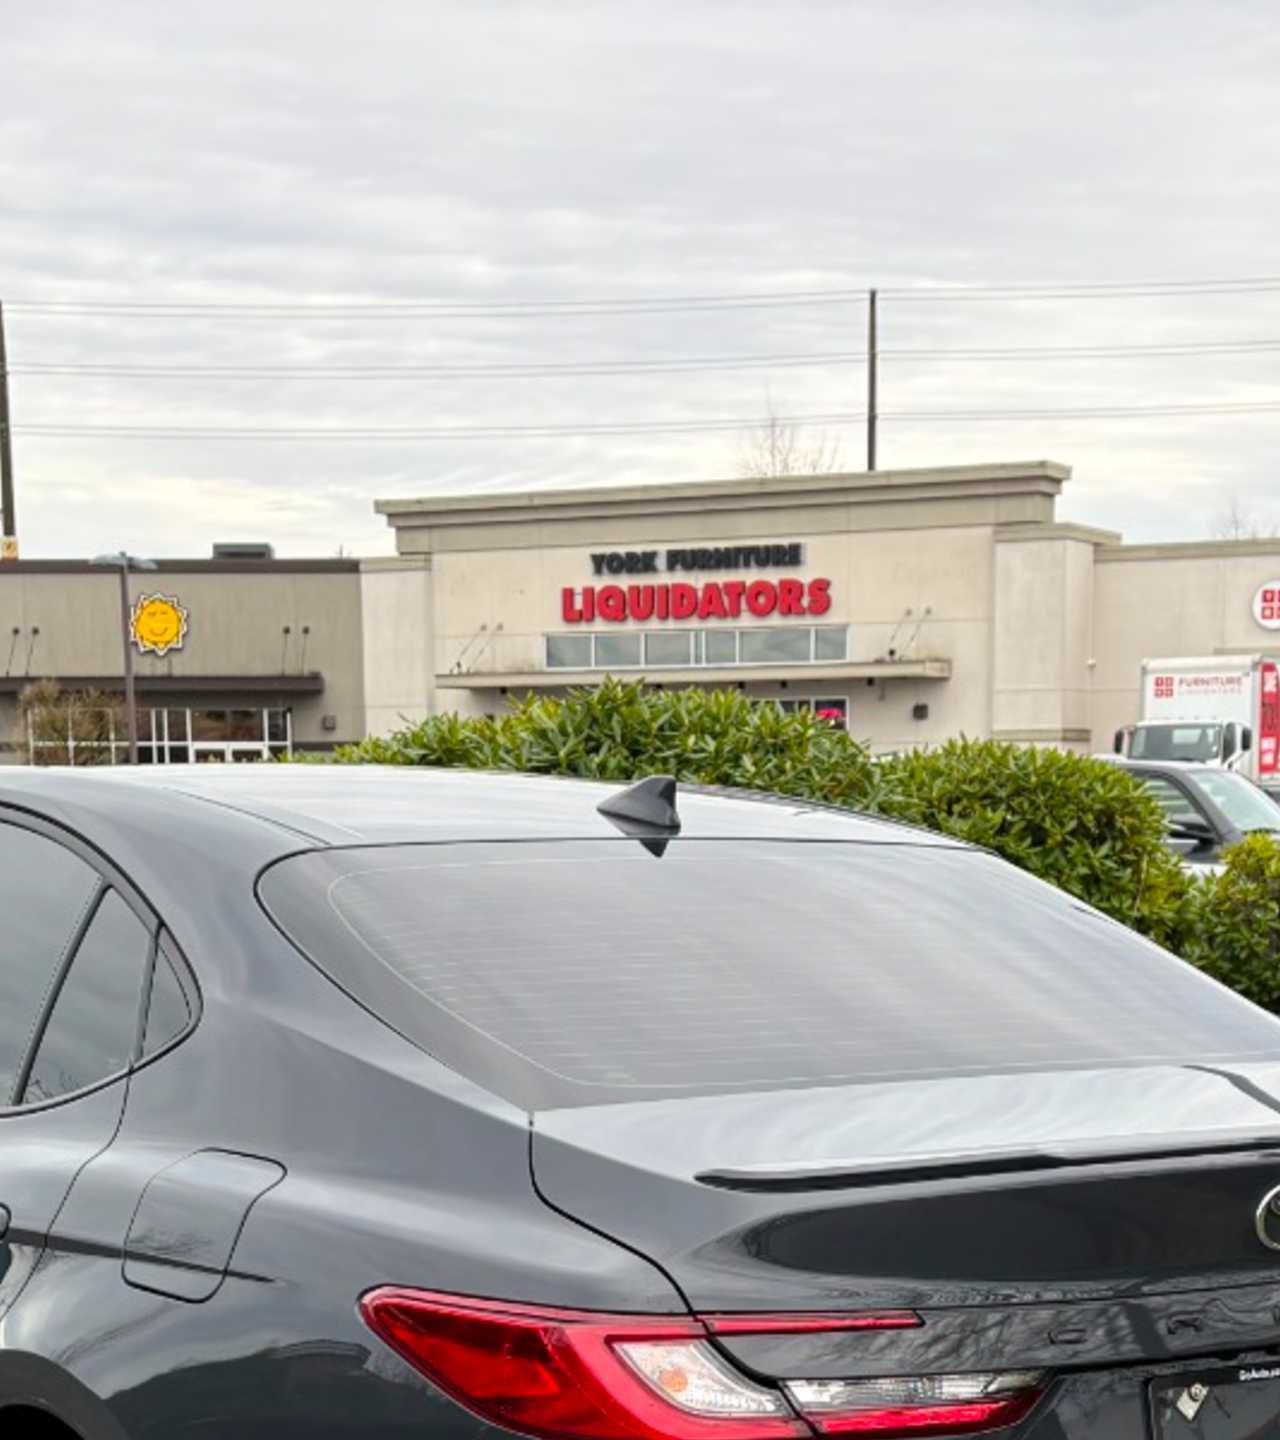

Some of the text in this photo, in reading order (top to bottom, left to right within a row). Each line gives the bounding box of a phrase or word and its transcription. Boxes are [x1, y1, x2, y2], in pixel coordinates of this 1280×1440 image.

[590, 543, 802, 575] YORK FURNITURE
[562, 578, 831, 623] LIQUIDATORS
